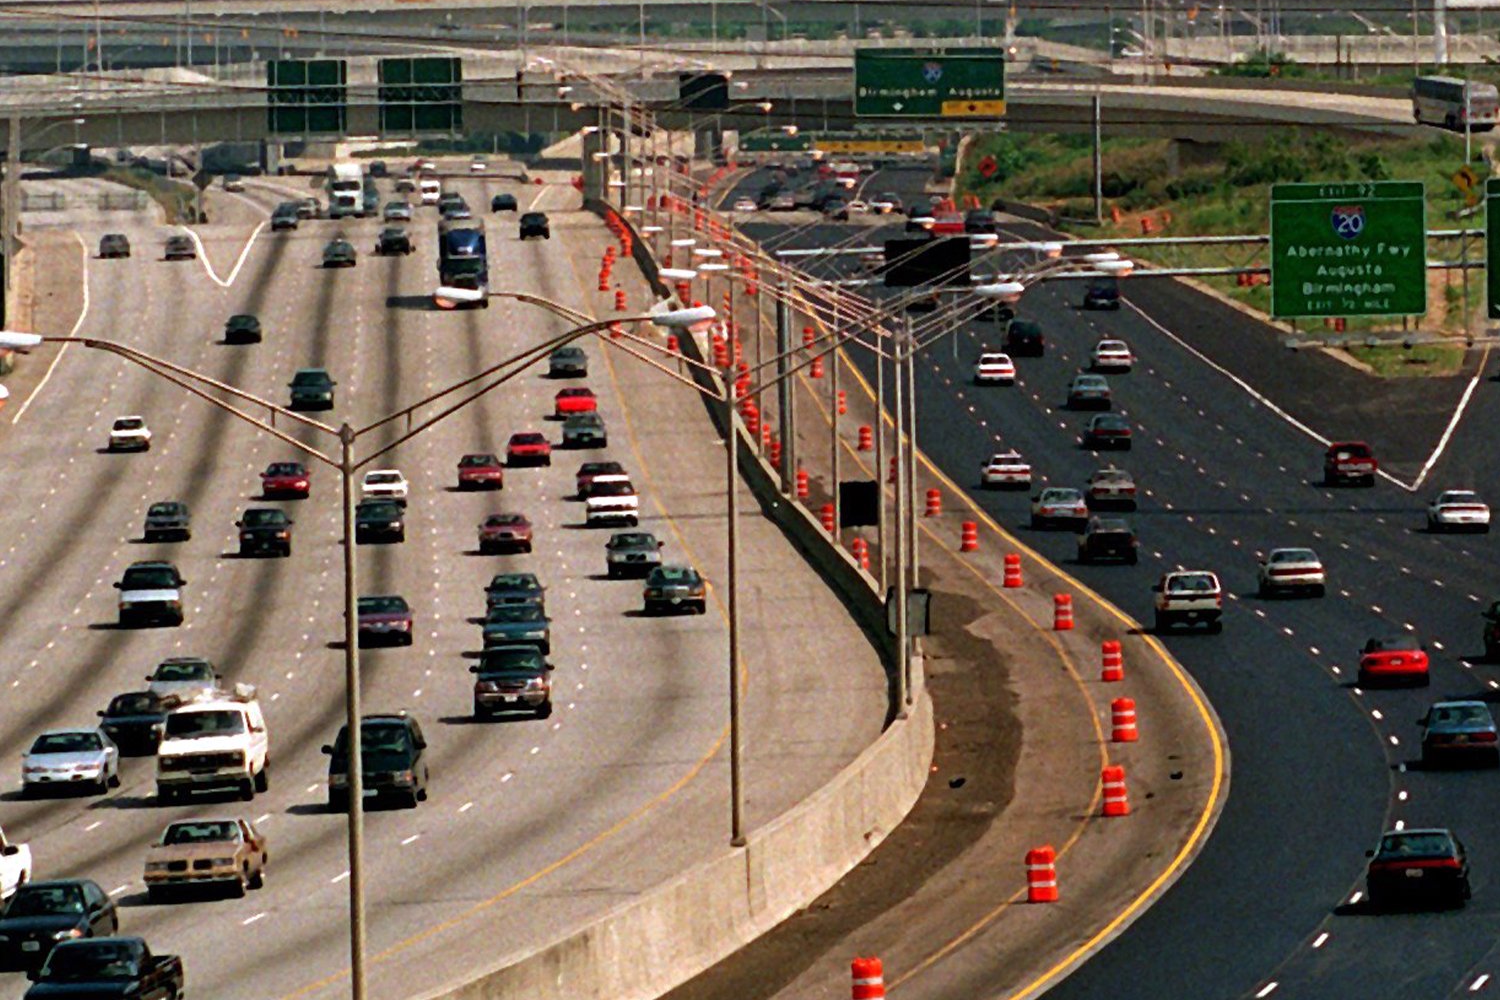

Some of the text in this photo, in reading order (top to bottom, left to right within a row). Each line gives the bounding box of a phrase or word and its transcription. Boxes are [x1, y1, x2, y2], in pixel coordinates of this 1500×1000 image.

[1337, 213, 1363, 233] 20
[1287, 242, 1411, 258] Abernathy Fwy
[1316, 263, 1383, 278] Augusta
[1302, 281, 1397, 297] Birmingham
